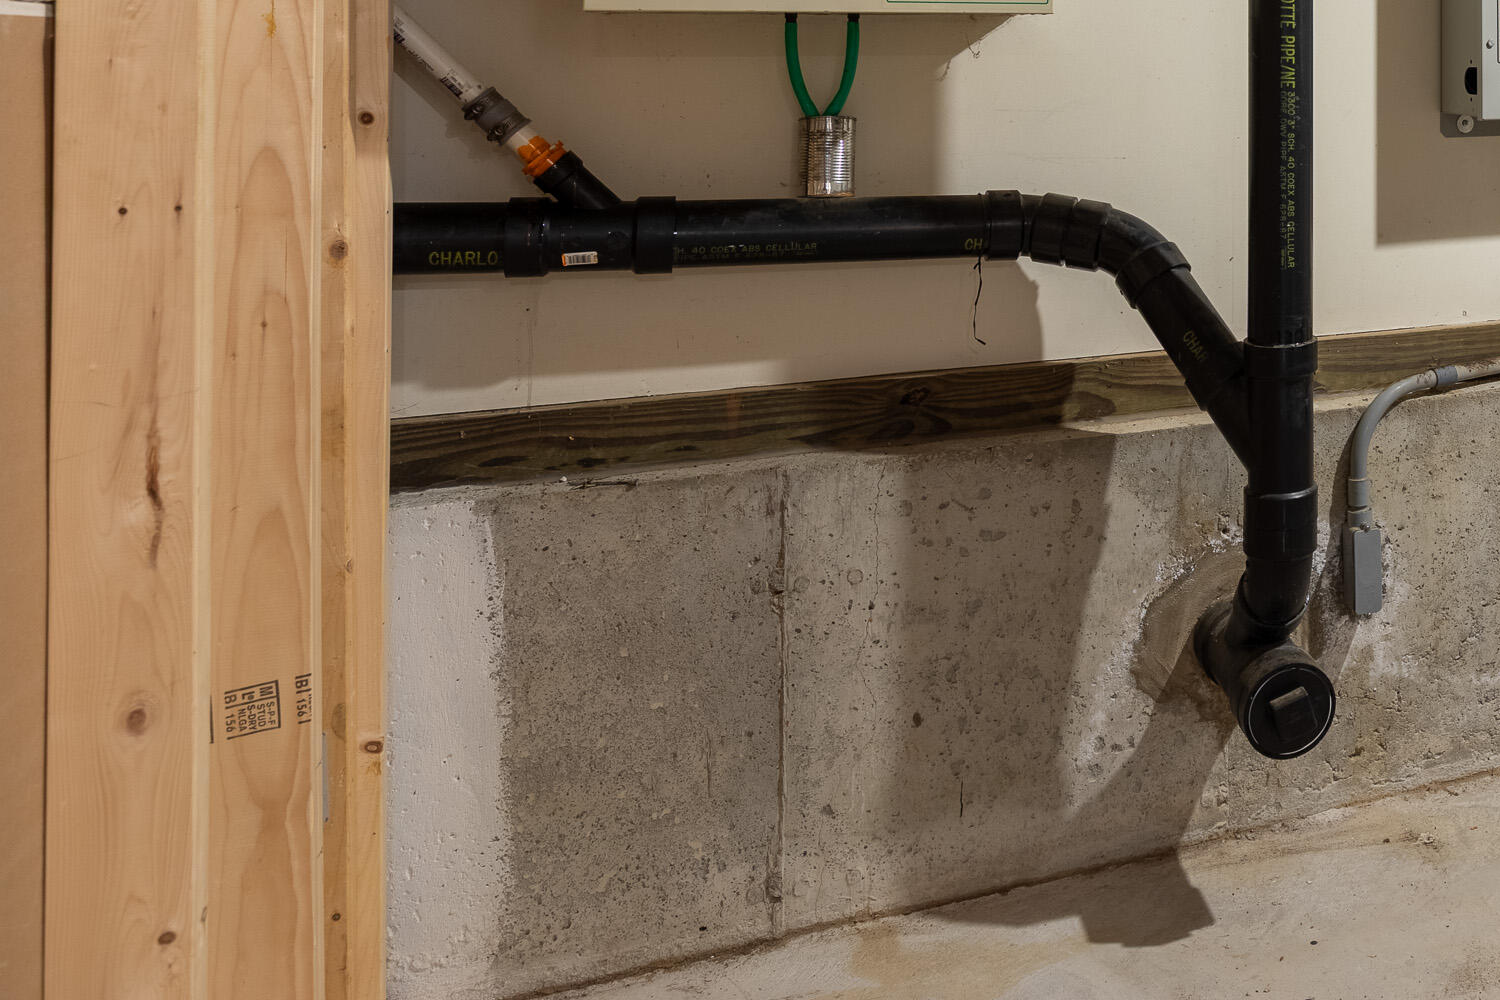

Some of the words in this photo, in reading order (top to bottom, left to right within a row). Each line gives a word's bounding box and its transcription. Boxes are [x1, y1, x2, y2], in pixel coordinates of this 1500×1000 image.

[1280, 35, 1296, 89] PIPE/NE
[1287, 156, 1296, 169] 40
[1287, 172, 1296, 196] COEX
[1287, 199, 1296, 217] ABS
[1287, 221, 1296, 268] CELLULAR
[428, 250, 499, 266] CHARLO
[259, 686, 274, 697] M
[247, 704, 257, 730] S-DRY
[256, 703, 267, 727] STUD
[296, 698, 307, 718] 156
[225, 713, 236, 733] 156
[238, 708, 248, 732] NLGA
